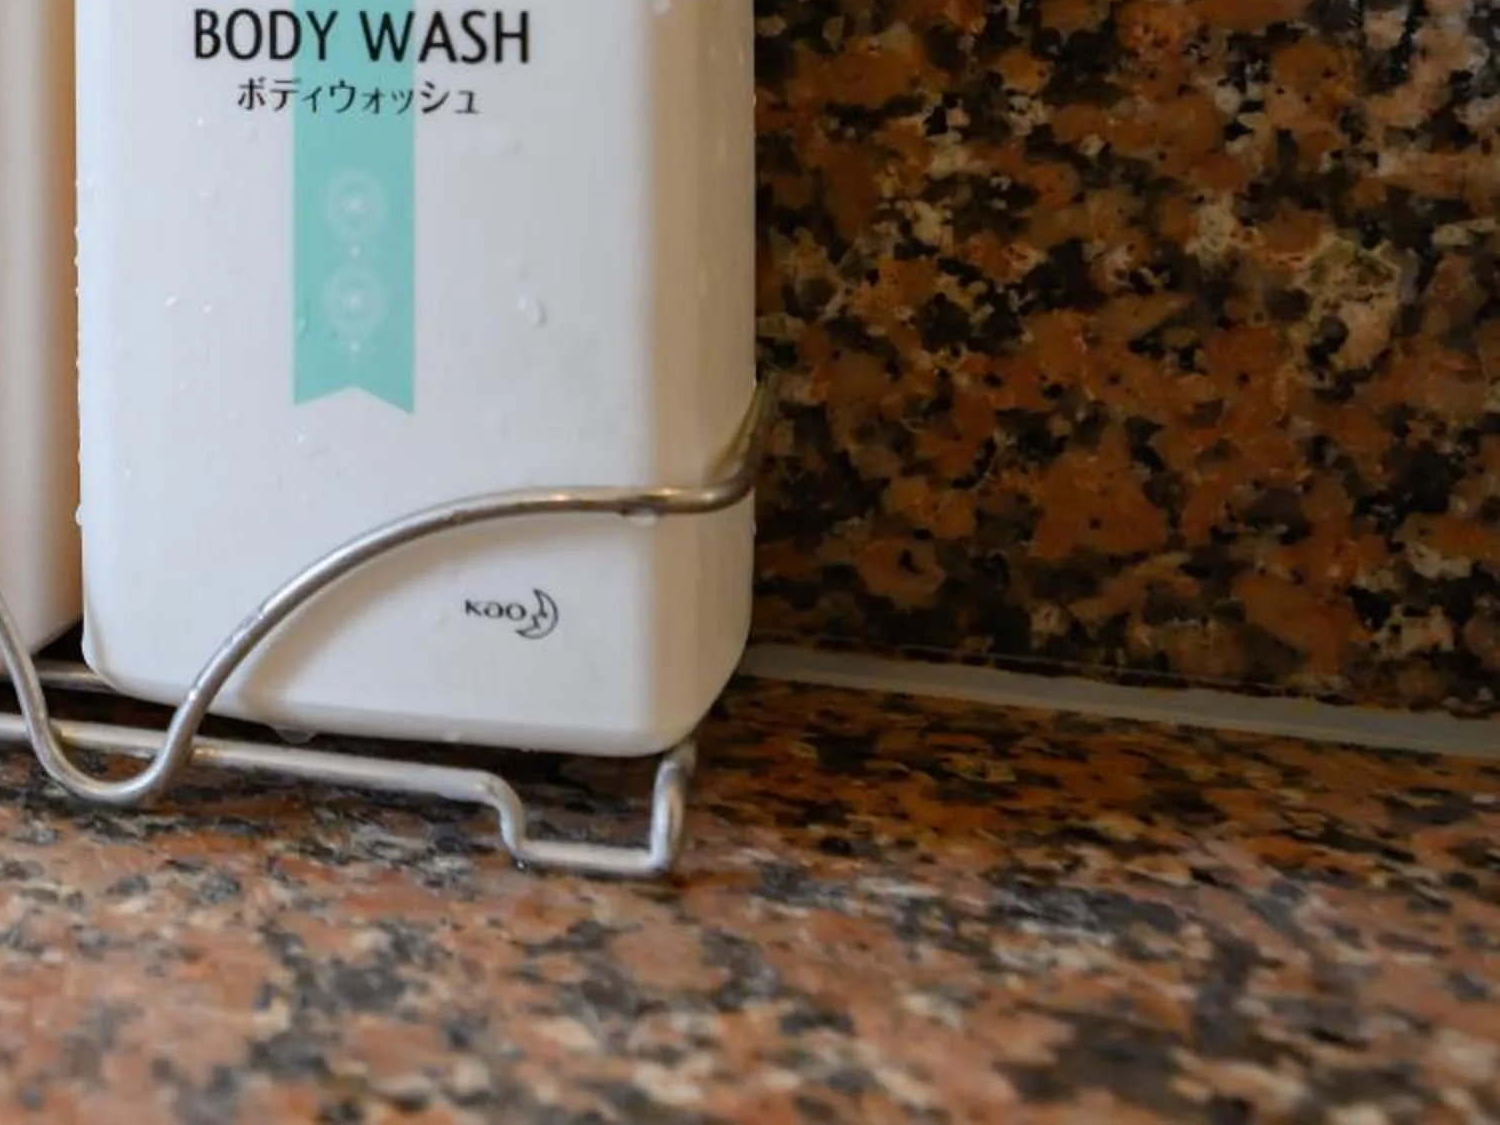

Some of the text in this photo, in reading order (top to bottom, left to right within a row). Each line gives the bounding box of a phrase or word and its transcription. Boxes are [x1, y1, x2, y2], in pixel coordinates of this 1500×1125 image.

[194, 8, 529, 63] BODY WASH
[237, 76, 480, 114] ボディウォッシュ
